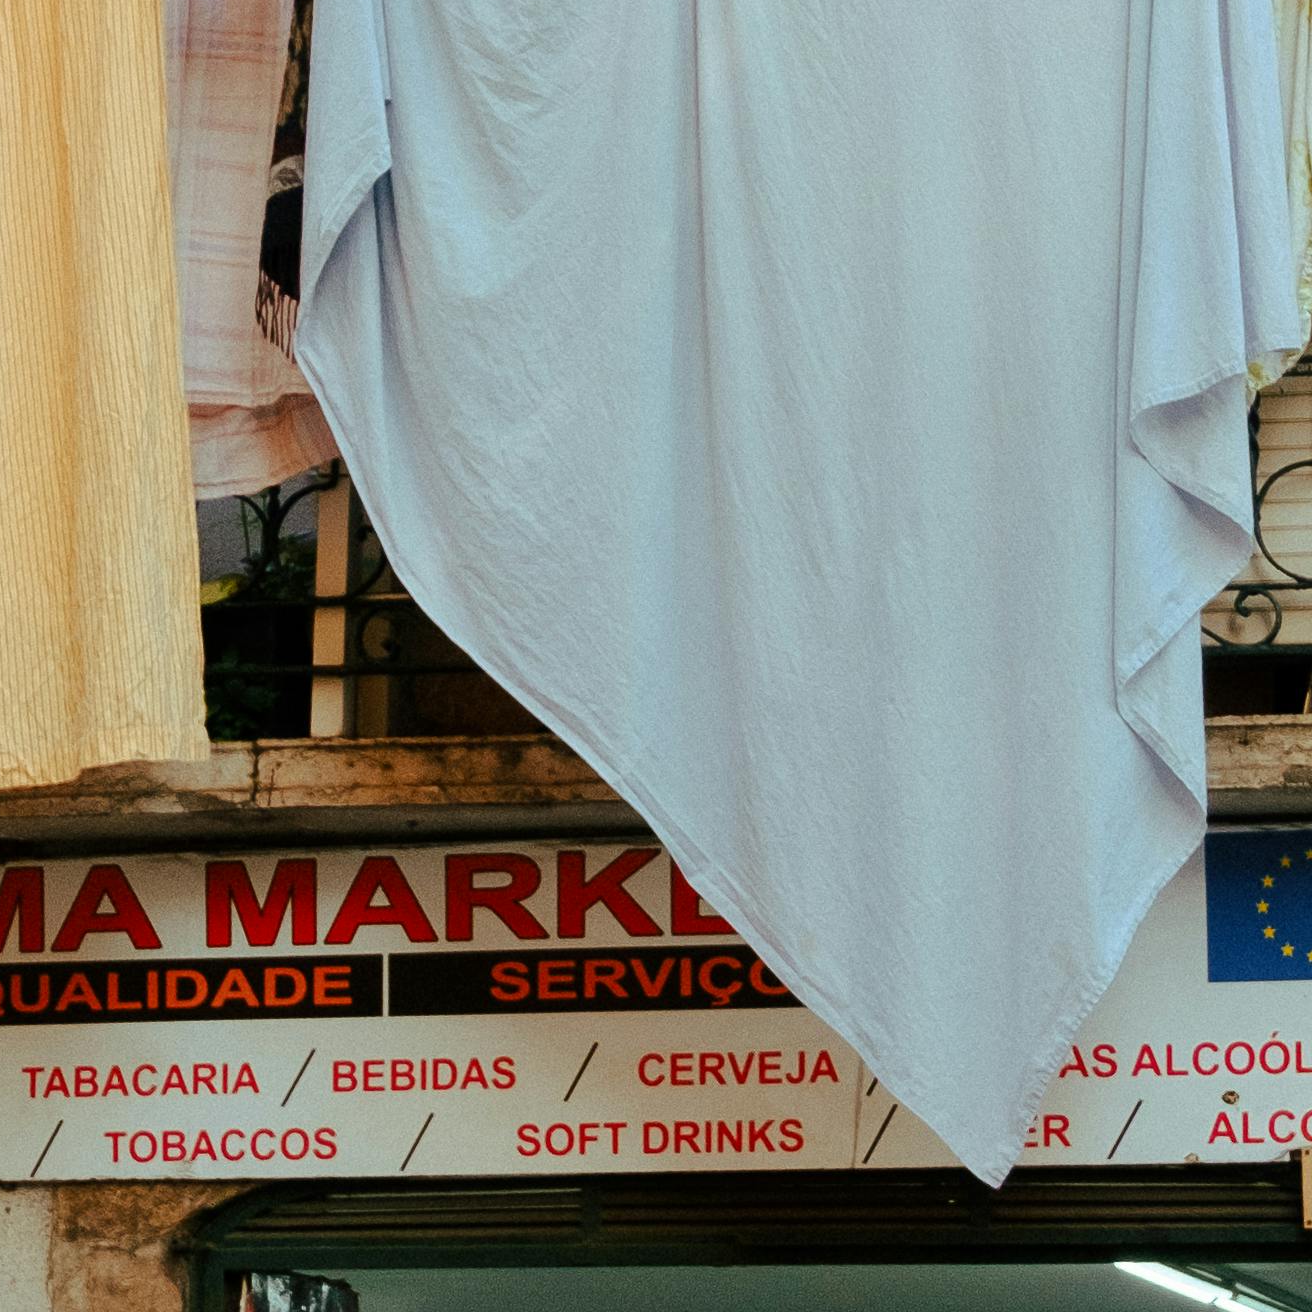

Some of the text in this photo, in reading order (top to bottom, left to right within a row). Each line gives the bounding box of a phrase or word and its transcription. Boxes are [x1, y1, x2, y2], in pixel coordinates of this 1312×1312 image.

[22, 1062, 260, 1099] TABACARIA
[331, 1055, 517, 1093] BEBIDAS
[637, 1049, 840, 1088] CERVEJA
[104, 1127, 338, 1164] TOBACCOS
[516, 1118, 805, 1157] SOFT DRINKS
